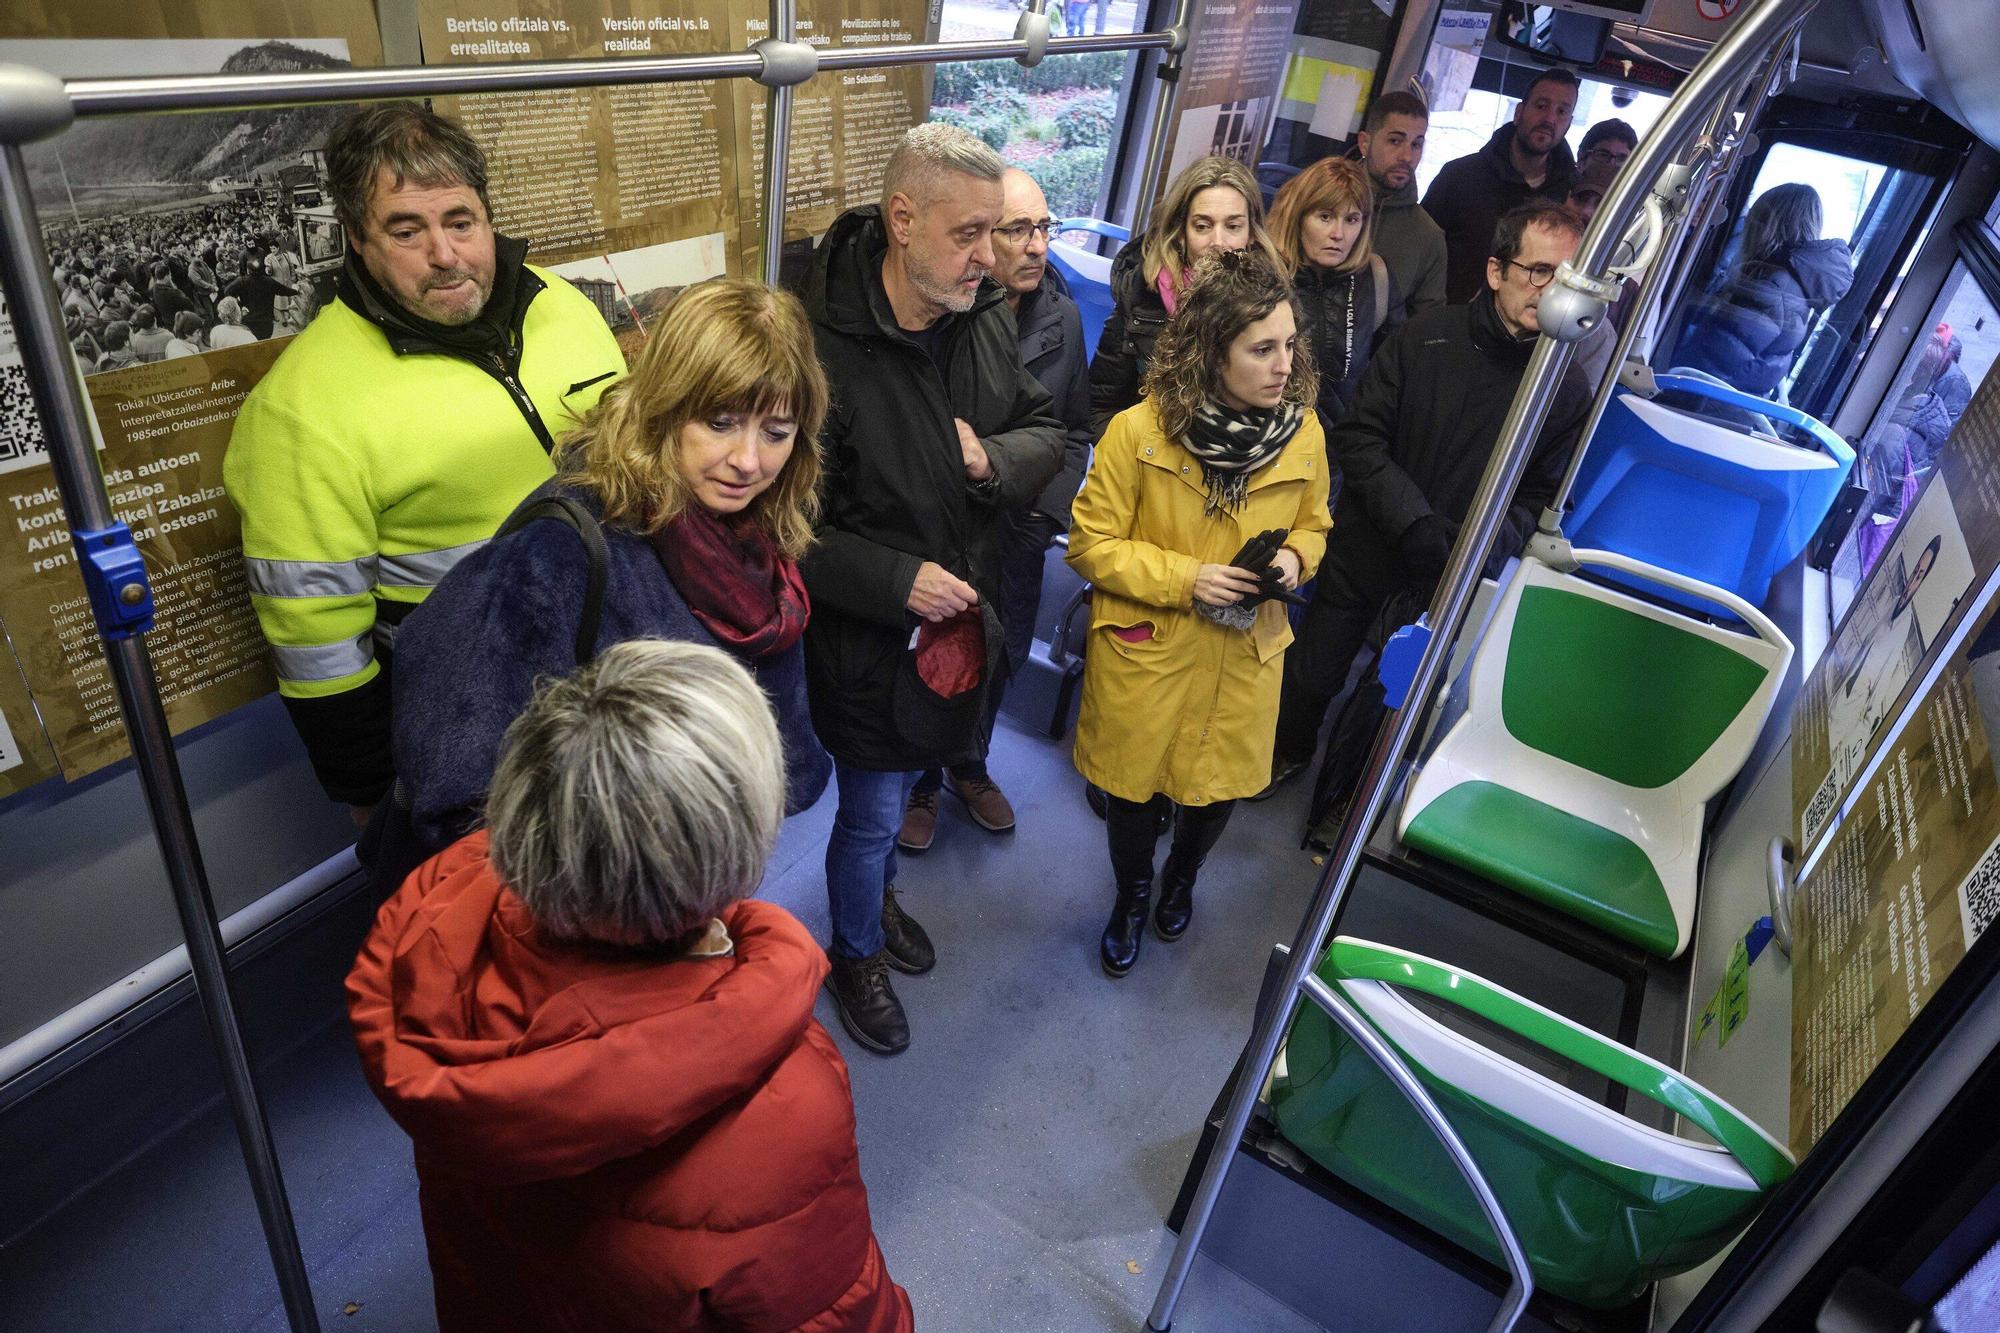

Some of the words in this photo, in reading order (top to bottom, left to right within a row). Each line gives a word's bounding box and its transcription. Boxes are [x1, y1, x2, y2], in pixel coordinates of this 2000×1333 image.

[447, 17, 497, 33] Bertsio
[501, 16, 549, 32] ofiziala
[552, 19, 570, 32] vs.
[602, 17, 645, 31] Versión
[648, 17, 681, 30] oficial
[683, 18, 698, 30] vs.
[699, 19, 709, 30] la
[746, 19, 768, 30] Mikel
[842, 19, 881, 28] Movilización
[882, 19, 890, 27] de
[891, 19, 900, 27] los
[842, 34, 881, 42] compañeros
[891, 32, 912, 42] trabajo
[451, 39, 530, 55] errealitatea
[604, 37, 651, 51] realidad
[800, 35, 830, 45] ostiako
[843, 76, 855, 85] San
[1346, 328, 1354, 352] BIMBA
[115, 398, 144, 412] Tokia
[146, 397, 152, 406] /
[152, 387, 204, 406] Ubicación:
[211, 379, 235, 391] Aribe
[120, 392, 252, 428] Interpretatzailea/interpreta
[127, 426, 170, 442] 1985ean
[172, 412, 230, 431] Orbaizetako
[9, 486, 60, 510] Trakt
[104, 470, 133, 486] eta
[138, 452, 200, 476] autoen
[28, 530, 70, 552] Arib
[33, 554, 67, 572] ren
[158, 509, 217, 535] ostean
[164, 560, 192, 576] Mikel
[192, 549, 239, 567] Zabalzare
[195, 582, 210, 591] eta
[153, 598, 202, 619] erakusten
[211, 589, 223, 598] du
[53, 612, 86, 628] hileta
[67, 650, 94, 664] kiak.
[176, 612, 196, 625] gisa
[72, 658, 106, 678] protes
[176, 615, 224, 636] familiaren
[76, 673, 103, 689] pasa
[81, 682, 112, 699] martx
[161, 656, 182, 667] zen.
[85, 696, 113, 710] turaz
[170, 665, 190, 678] goiz
[197, 651, 224, 666] baten
[89, 706, 119, 722] ekintz
[182, 669, 209, 684] zuten
[93, 718, 123, 734] bidez
[179, 680, 212, 698] aukera
[214, 669, 240, 683] eman
[1887, 764, 1899, 822] Zabalzaren
[1892, 819, 1904, 862] gorpua
[1908, 818, 1918, 852] Mikel
[1900, 885, 1908, 904] de
[1912, 865, 1925, 921] Sacando
[1901, 899, 1912, 938] Mikel
[1918, 921, 1928, 937] el
[1886, 915, 1901, 977] Bidasoa
[1919, 936, 1930, 986] cuerpo
[1904, 933, 1916, 992] Zabalza
[1909, 992, 1920, 1018] del
